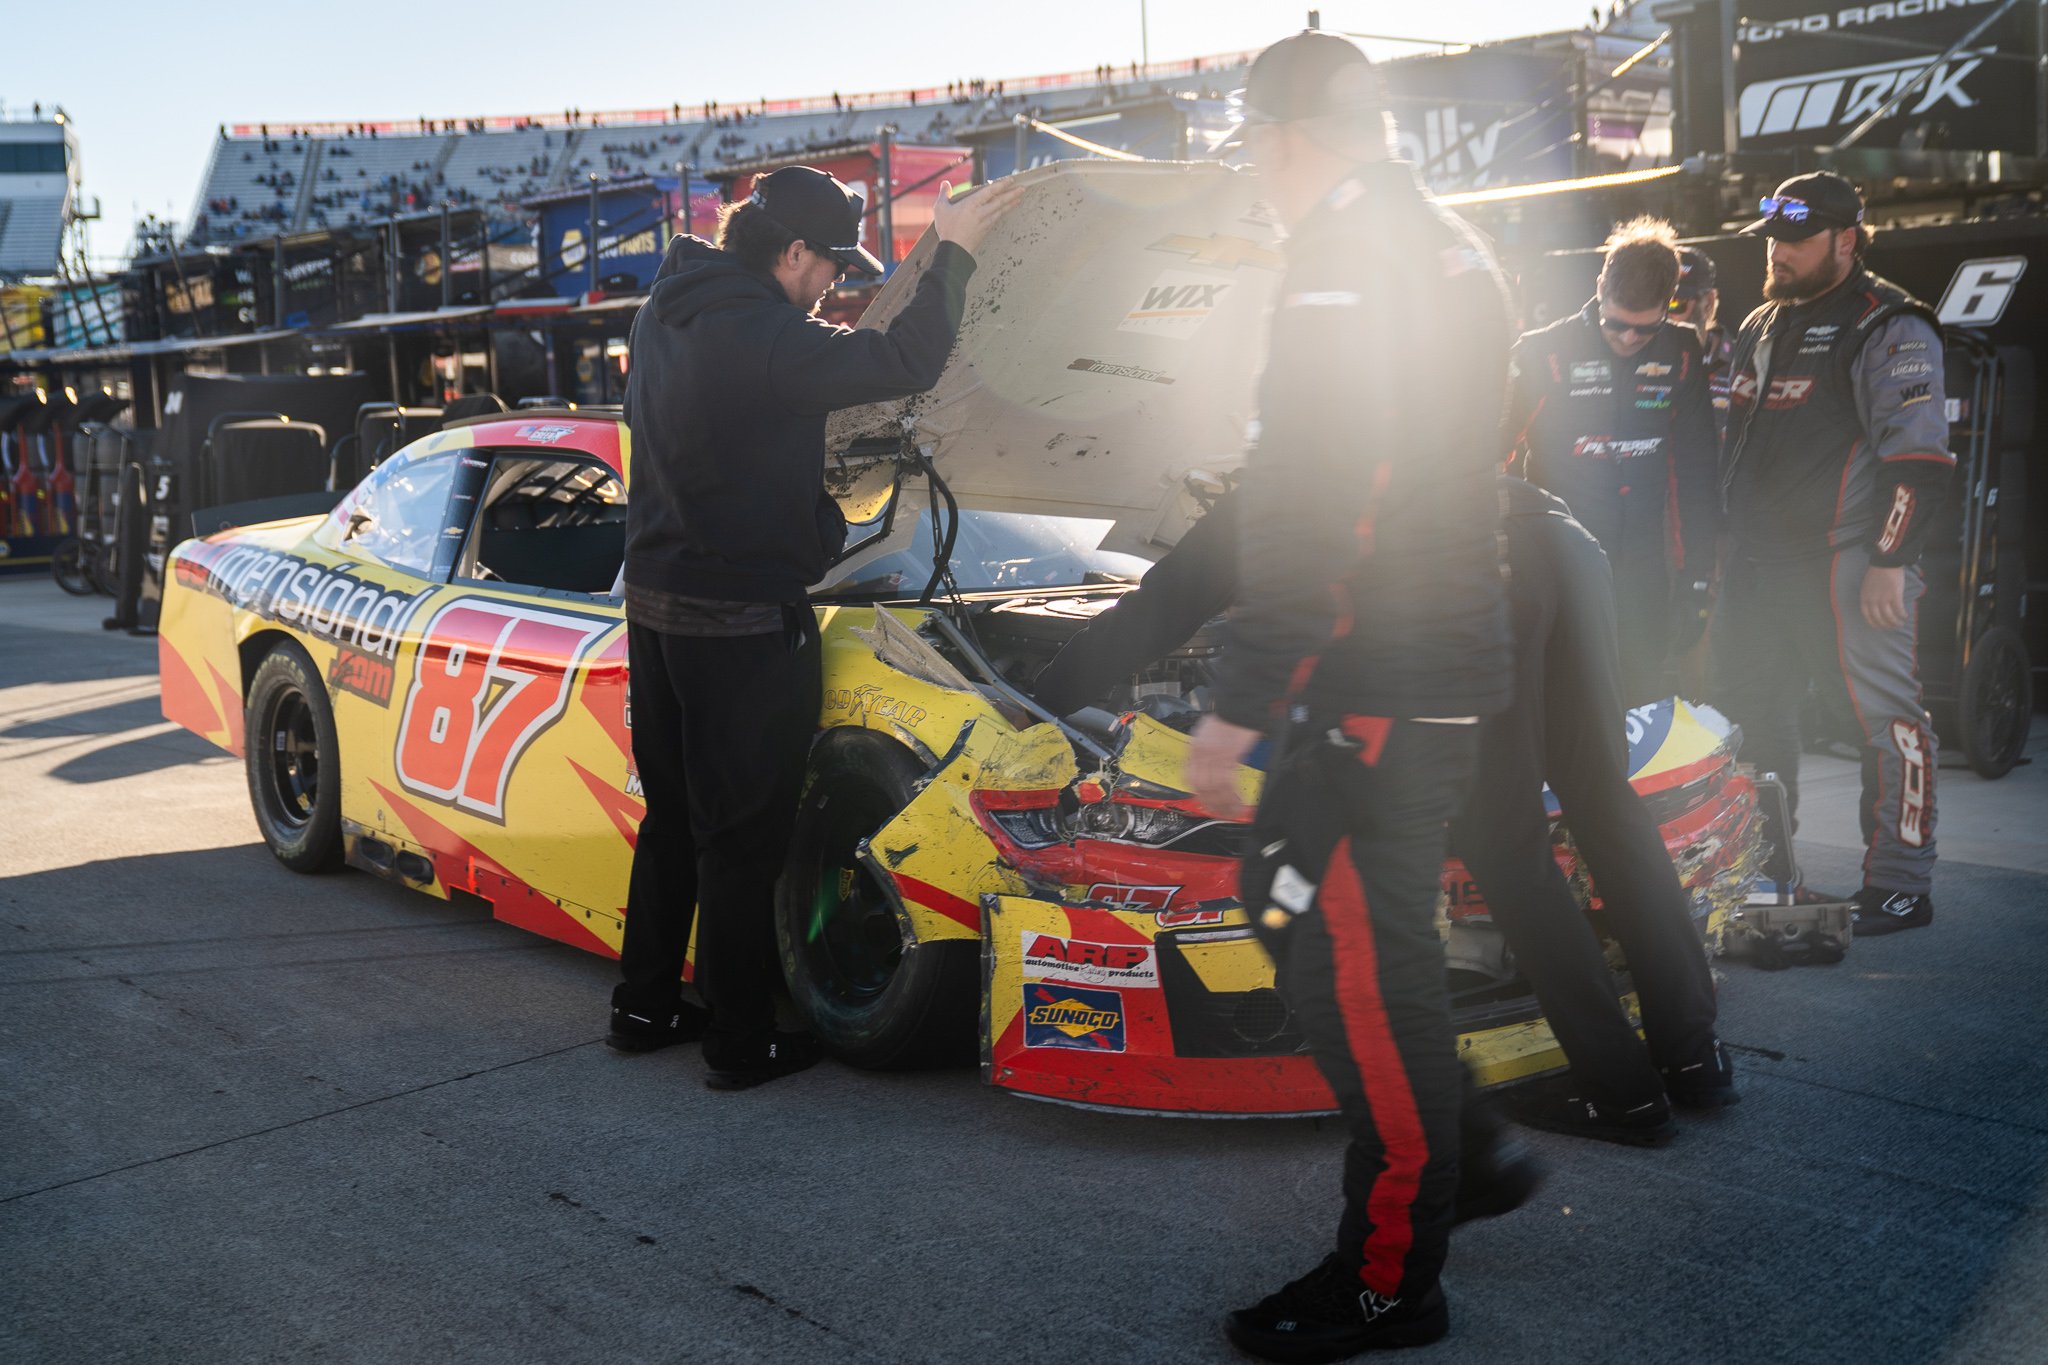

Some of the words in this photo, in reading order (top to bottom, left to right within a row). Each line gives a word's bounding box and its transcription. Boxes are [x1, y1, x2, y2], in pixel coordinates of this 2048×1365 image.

[1837, 0, 2000, 27] RACIN
[1838, 56, 1983, 125] RFK
[1140, 284, 1232, 311] WIX
[1935, 255, 2028, 327] 6
[394, 594, 626, 827] 87
[1892, 722, 1924, 848] ECR
[1024, 957, 1080, 972] automotive
[1107, 969, 1154, 978] products
[1026, 934, 1149, 969] ARP
[1032, 1007, 1118, 1028] SUNOCO
